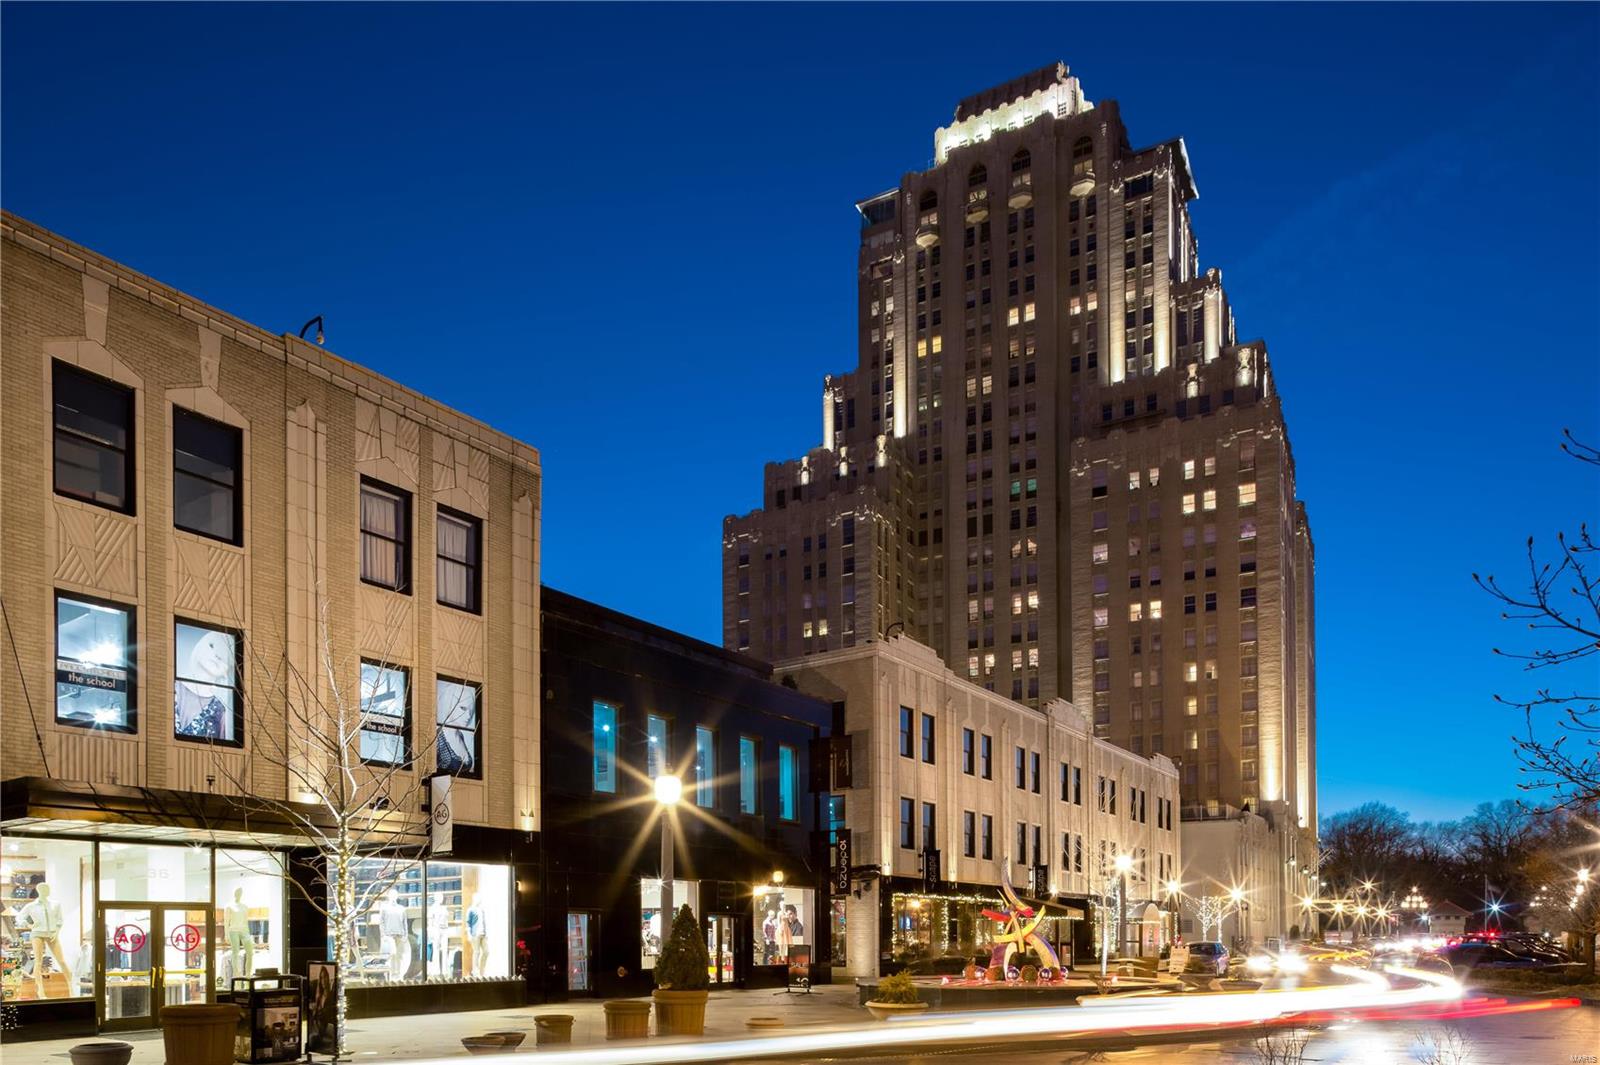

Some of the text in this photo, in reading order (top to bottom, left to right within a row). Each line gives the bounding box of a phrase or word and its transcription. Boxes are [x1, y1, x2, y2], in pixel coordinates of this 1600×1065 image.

[68, 672, 116, 688] the school
[377, 724, 397, 734] school
[118, 933, 141, 944] AG
[174, 933, 196, 944] AG
